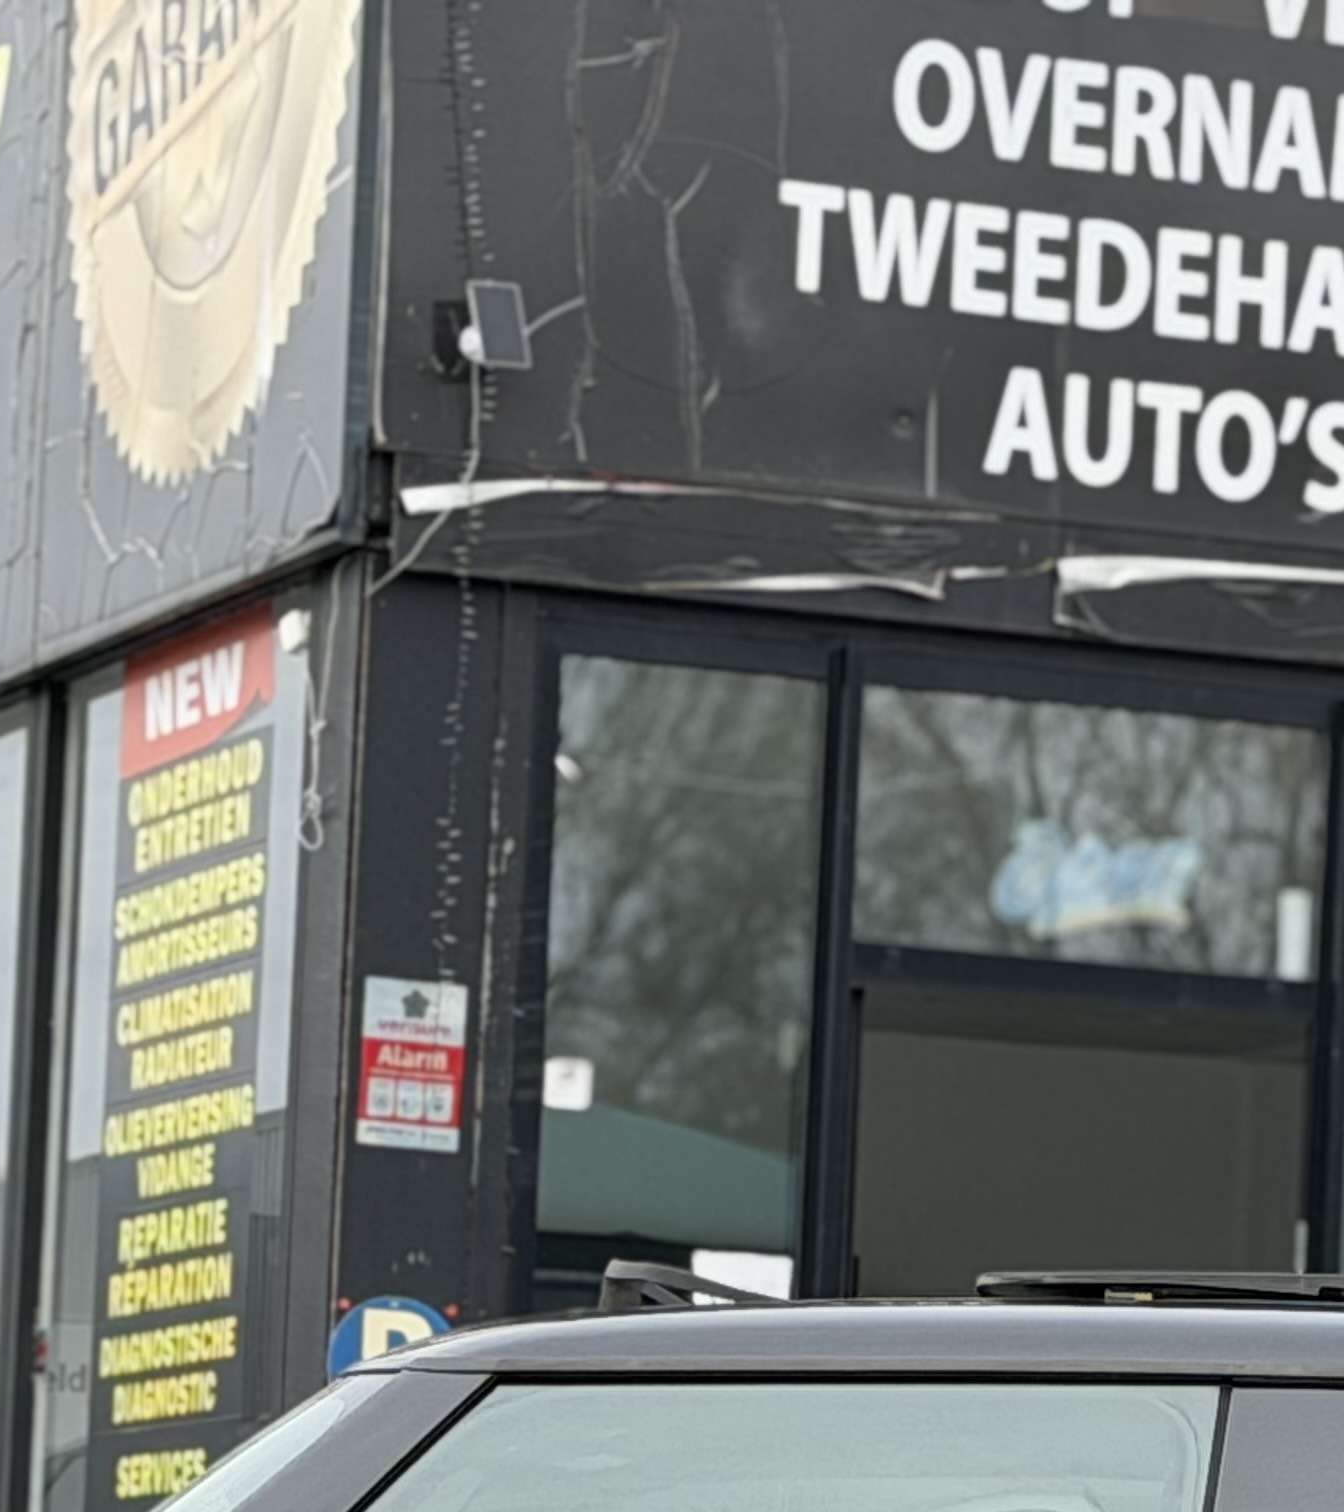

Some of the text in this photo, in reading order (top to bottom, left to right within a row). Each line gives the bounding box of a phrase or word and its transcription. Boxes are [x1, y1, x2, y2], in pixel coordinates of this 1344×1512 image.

[144, 641, 244, 741] NEW
[128, 739, 263, 827] ONDERHOUD
[135, 790, 250, 872] ENTRETIEN
[115, 852, 265, 940] SCHOKDEMPERS
[116, 904, 257, 988] AMORTISSEURS
[117, 970, 253, 1046] CLIMATISATION
[131, 1026, 233, 1090] RADIATEUR
[103, 1084, 254, 1157] OLIEVERVERSING
[137, 1144, 215, 1198] VIDANGE
[118, 1198, 228, 1264] REPARATIE
[100, 1316, 237, 1377] DIAGNOSTISCHE
[112, 1371, 217, 1425] DIAGNOSTIC
[115, 1448, 208, 1499] SERVICES
